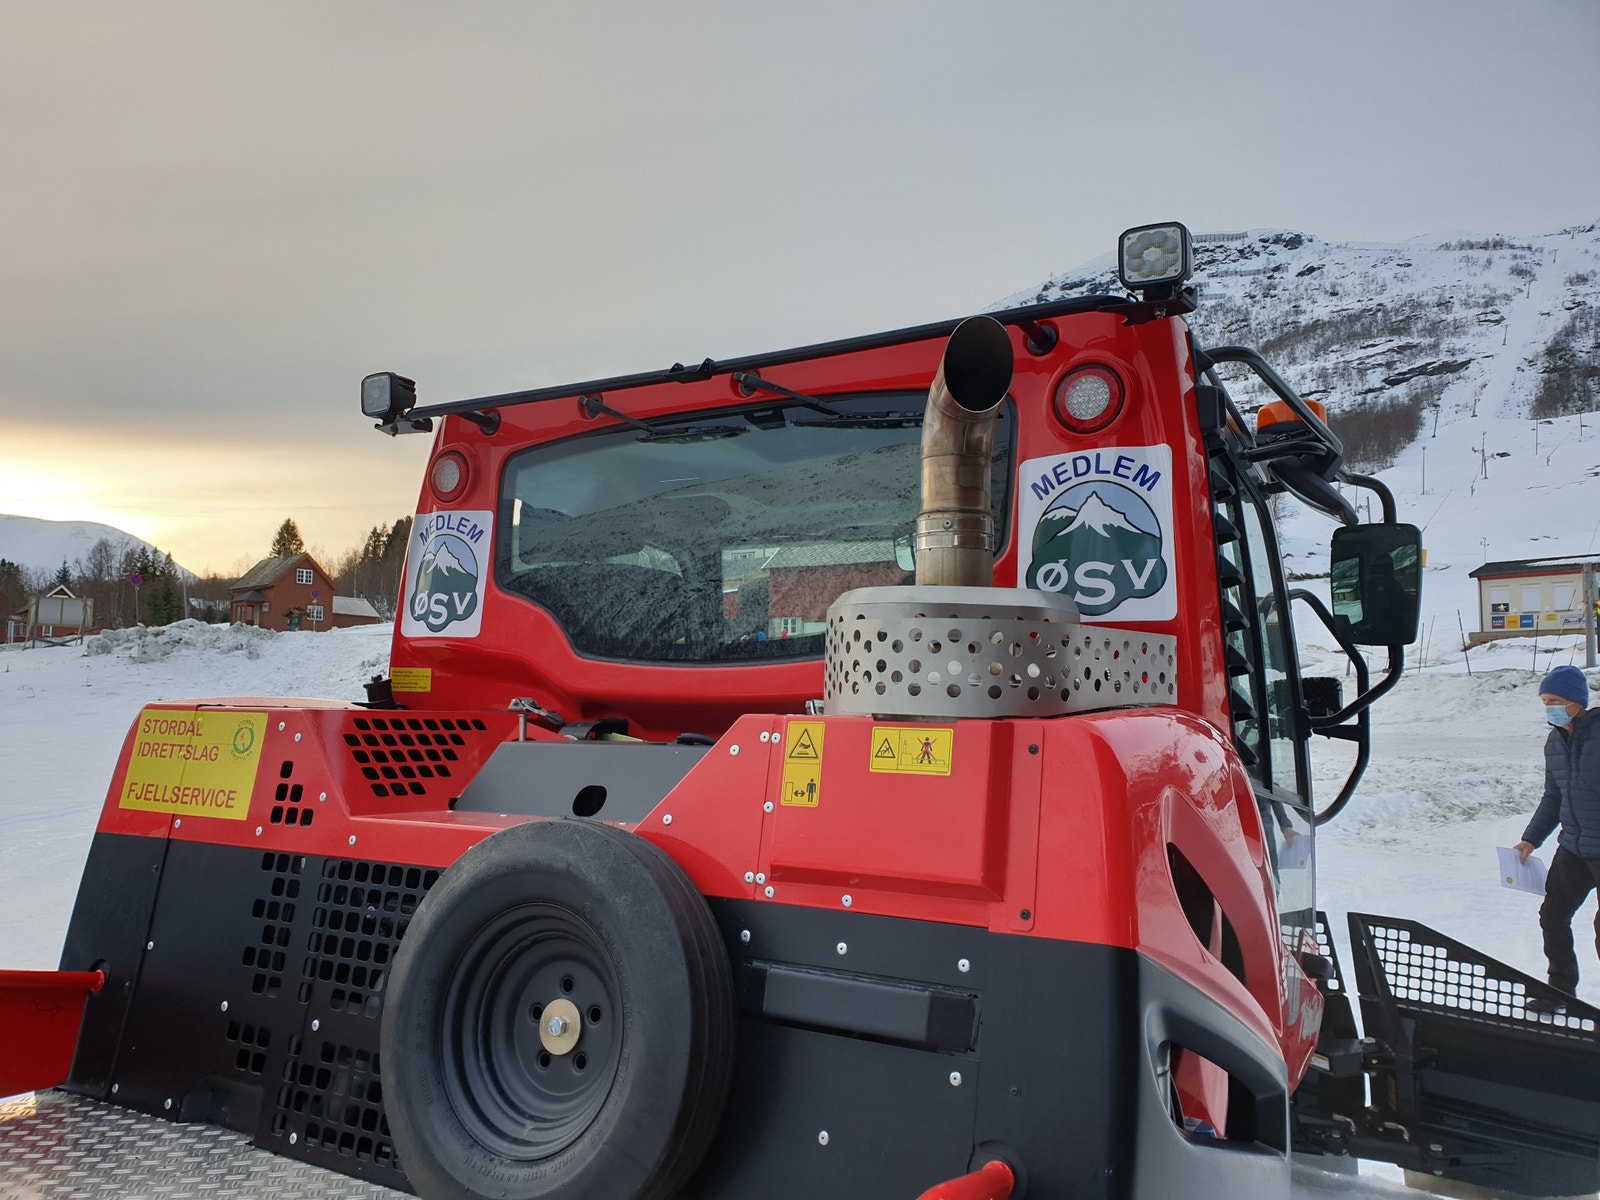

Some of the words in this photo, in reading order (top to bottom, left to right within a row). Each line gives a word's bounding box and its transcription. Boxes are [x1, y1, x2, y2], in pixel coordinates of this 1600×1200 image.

[1030, 452, 1162, 501] MEDLEM
[419, 514, 483, 545] MEDLEM
[1036, 558, 1158, 606] ØSV
[414, 591, 473, 624] ØSV
[142, 719, 204, 737] STORDAL
[137, 742, 219, 762] IDRETTSLAG
[127, 782, 237, 808] FJELLSERVICE
